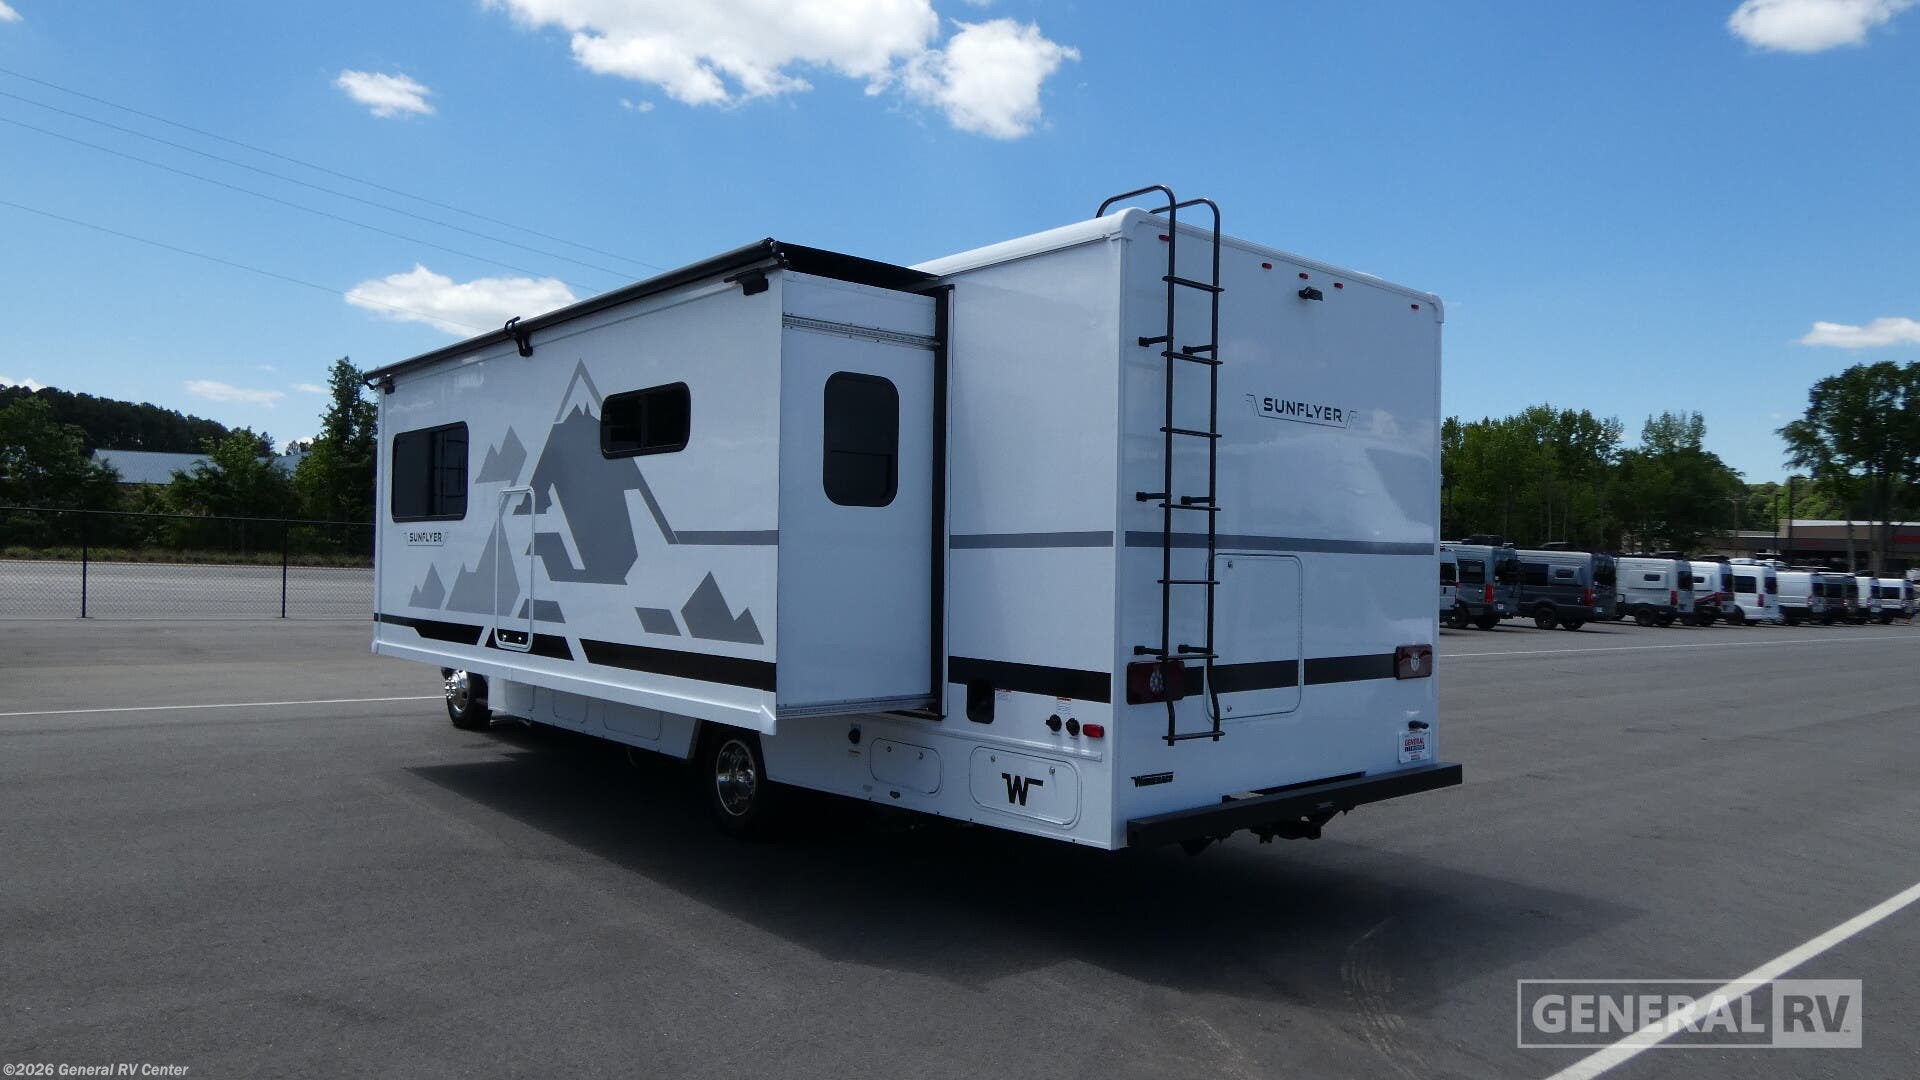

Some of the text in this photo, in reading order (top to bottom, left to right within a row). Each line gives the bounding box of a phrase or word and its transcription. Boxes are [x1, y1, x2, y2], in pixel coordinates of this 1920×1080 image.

[1263, 397, 1343, 423] SUNFLYER
[409, 532, 442, 542] SUNFLYER
[1001, 772, 1044, 807] W
